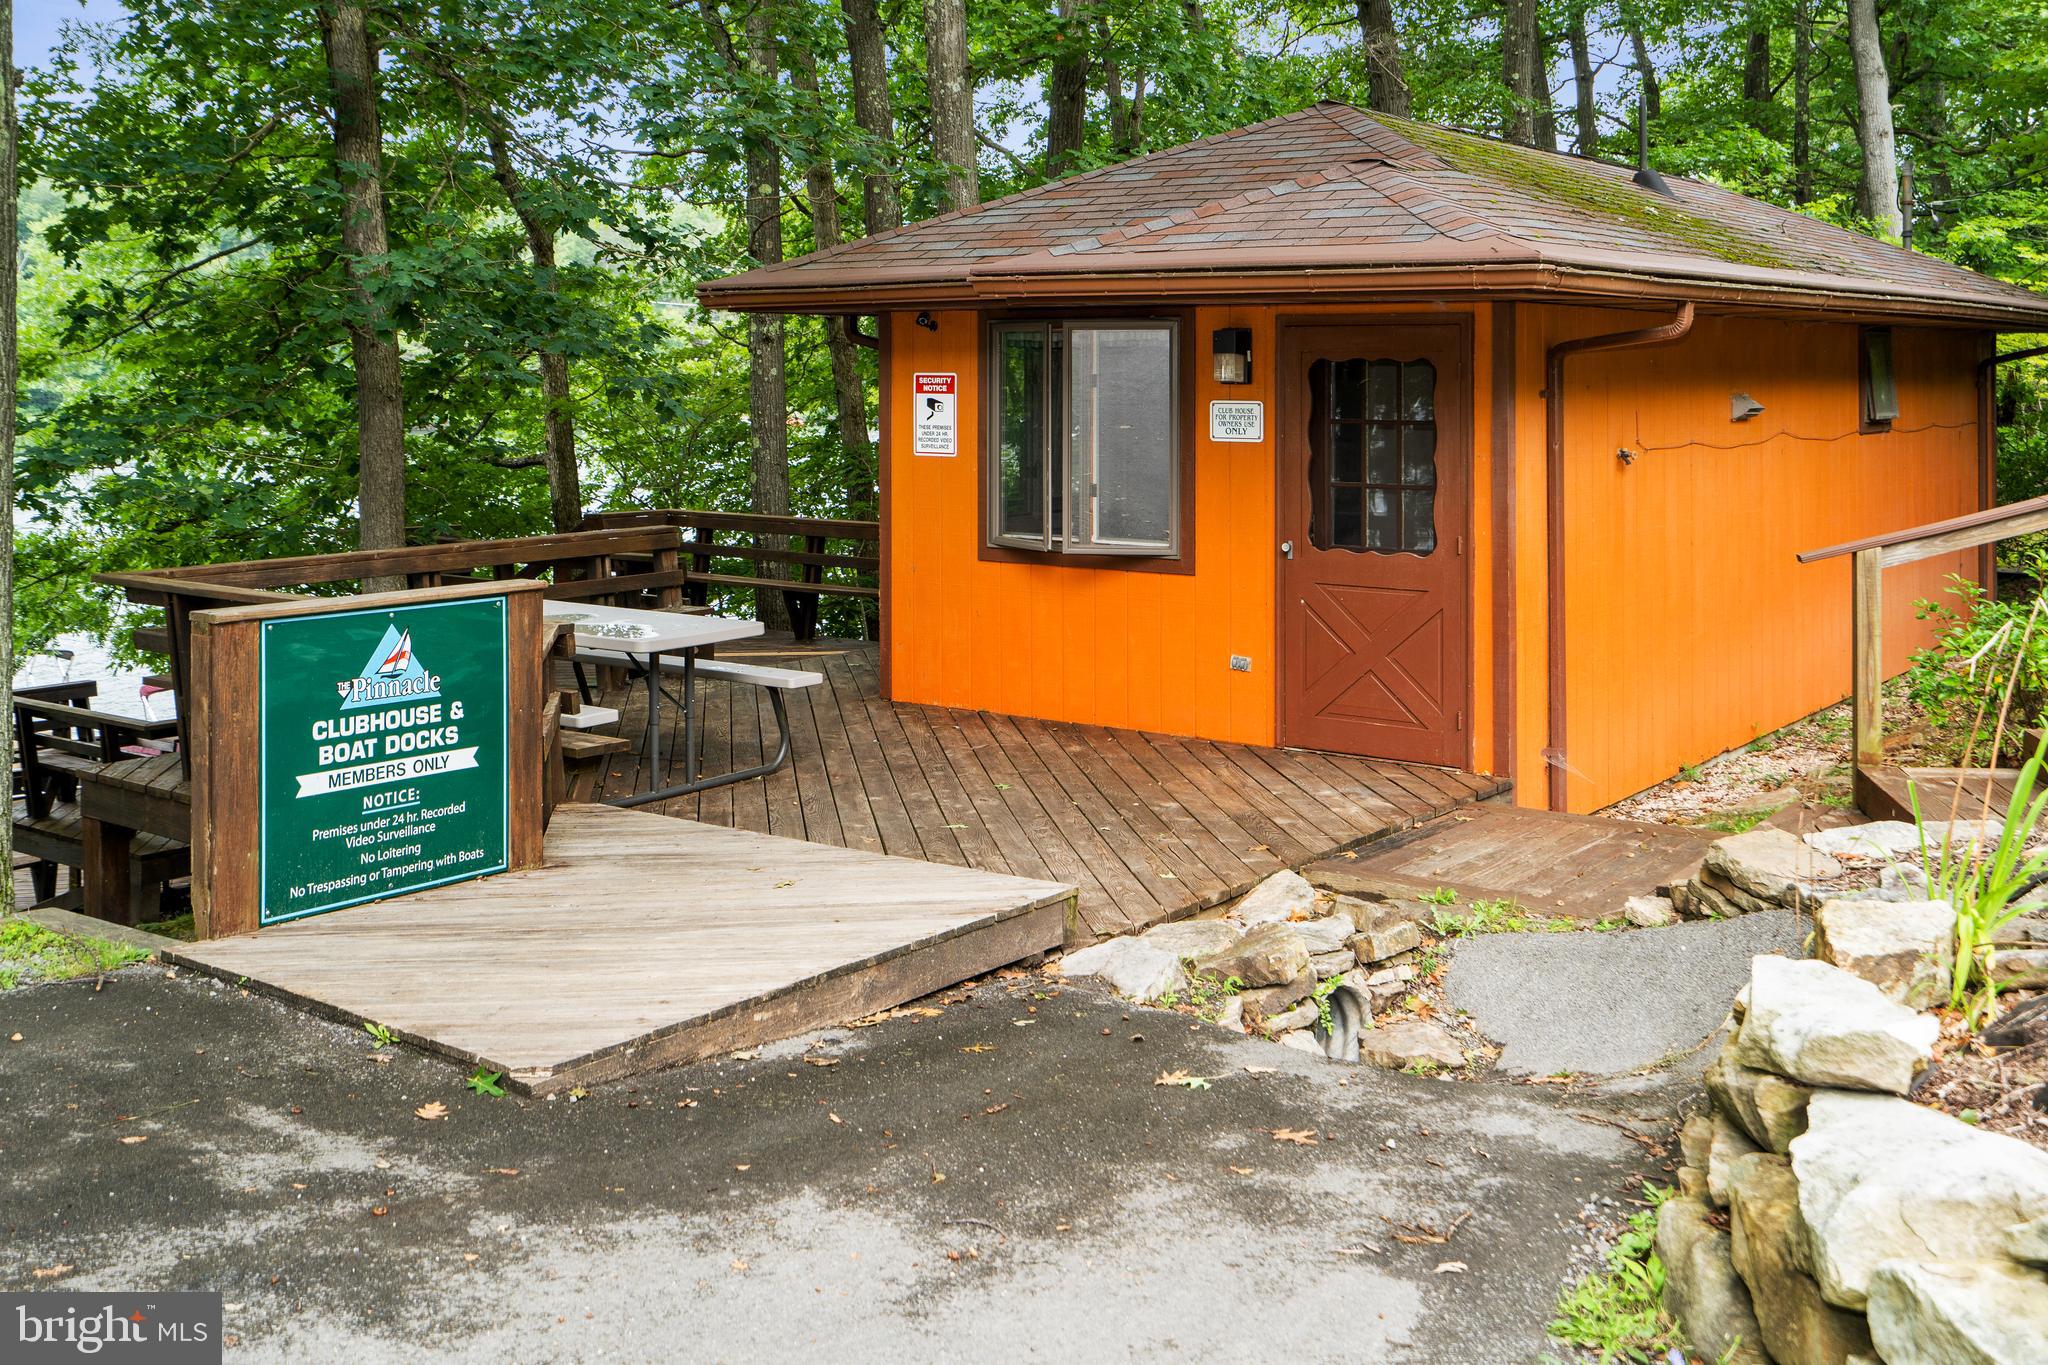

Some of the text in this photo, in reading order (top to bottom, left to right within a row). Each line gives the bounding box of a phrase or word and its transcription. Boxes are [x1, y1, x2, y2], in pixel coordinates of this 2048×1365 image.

[337, 670, 441, 702] THE Pinnacle
[312, 701, 464, 741] CLUBHOUSE &
[319, 726, 459, 766] BOAT DOCKS
[328, 755, 450, 788] MEMBERS ONLY
[362, 788, 420, 810] NOTICE:
[312, 801, 466, 842] Premises under 24 hr. Recorded
[346, 822, 436, 848] Video Surveillance
[360, 844, 422, 864] No Loitering
[290, 848, 484, 899] No Trespassing or Tampering with Boats
